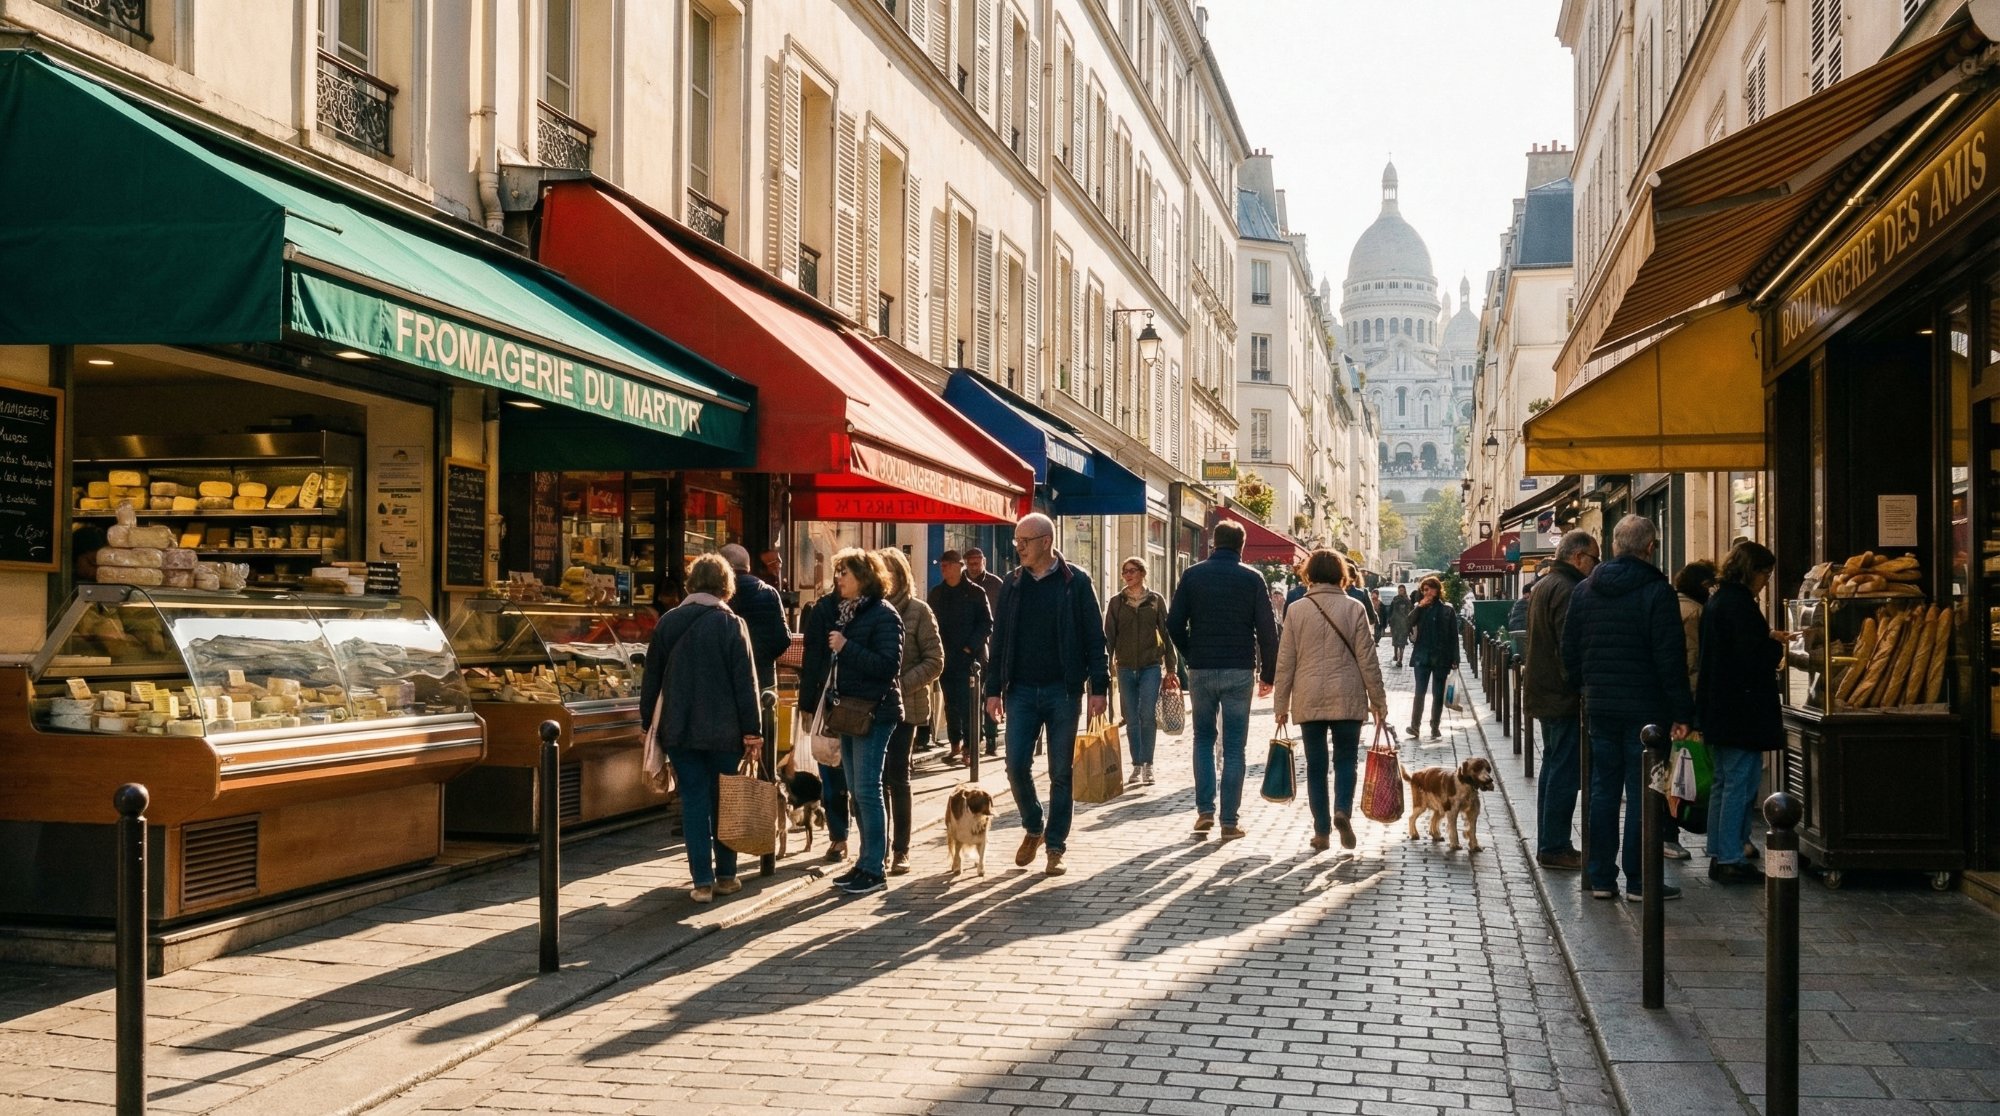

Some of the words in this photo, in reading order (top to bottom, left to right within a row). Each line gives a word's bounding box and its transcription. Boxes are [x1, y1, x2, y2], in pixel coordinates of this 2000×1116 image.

[1782, 229, 1877, 347] BOULANGERIE
[1883, 190, 1920, 265] DES
[1929, 130, 1987, 228] AMIS
[396, 307, 574, 400] FROMAGERIE
[583, 369, 614, 411] DU
[623, 383, 703, 434] MARTYR
[879, 451, 945, 496] BOULANGERIE
